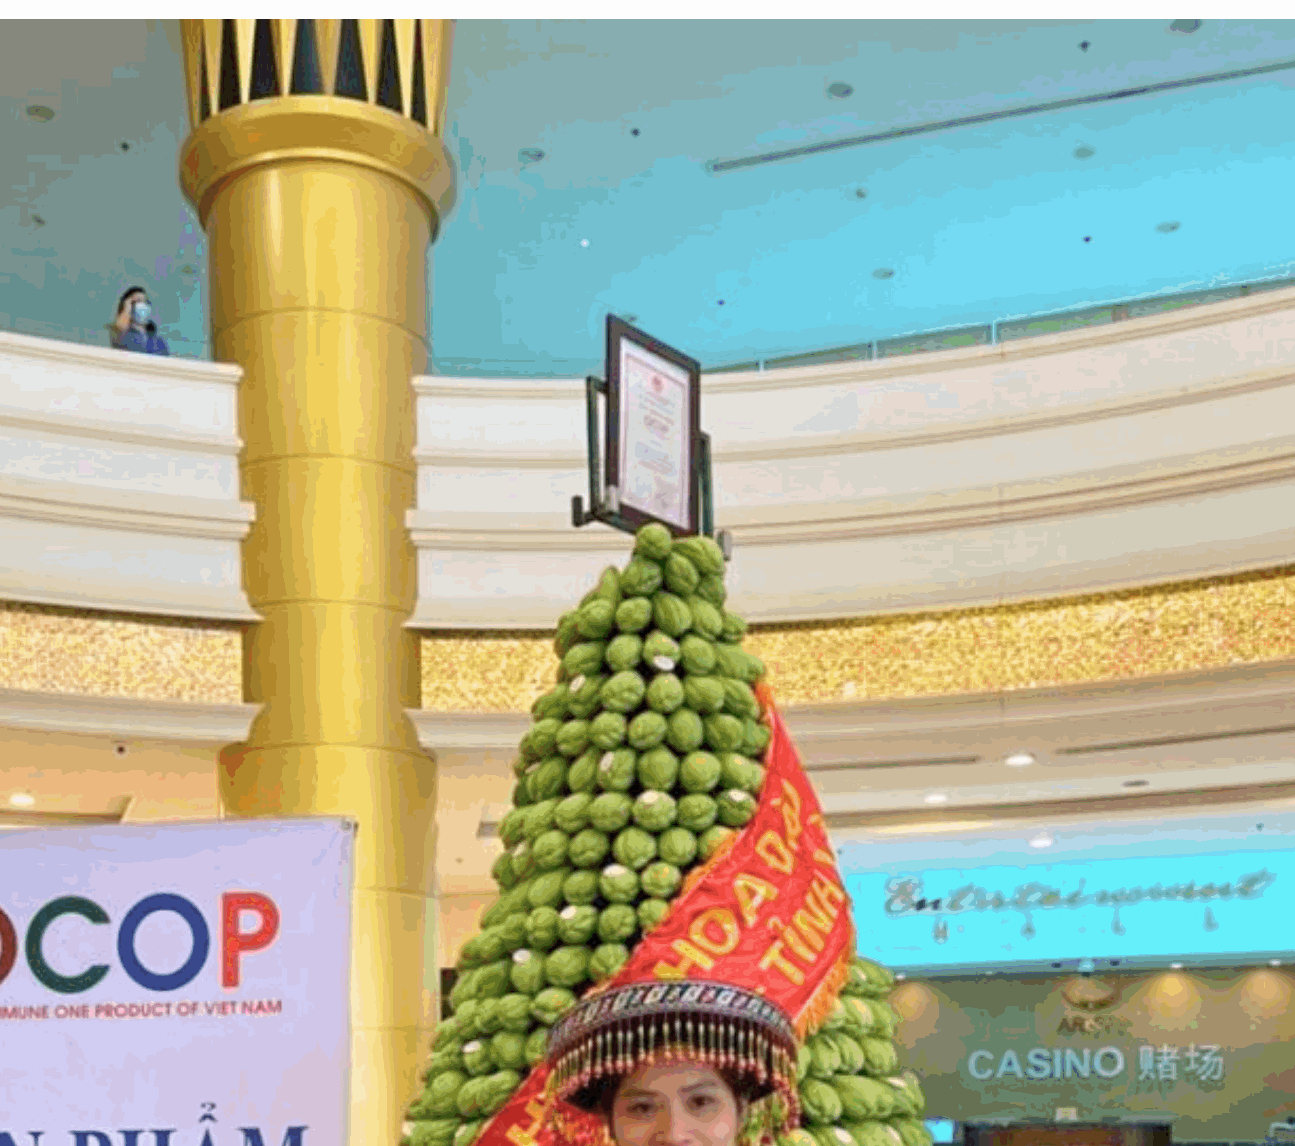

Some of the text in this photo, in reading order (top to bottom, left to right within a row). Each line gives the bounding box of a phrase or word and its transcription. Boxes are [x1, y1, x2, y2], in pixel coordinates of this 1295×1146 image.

[759, 869, 845, 986] TỈNH
[55, 1004, 90, 1019] ONE
[94, 1002, 172, 1018] PRODUCT
[176, 1001, 199, 1017] OF
[241, 999, 282, 1015] NAM
[968, 1046, 1124, 1080] CASINO
